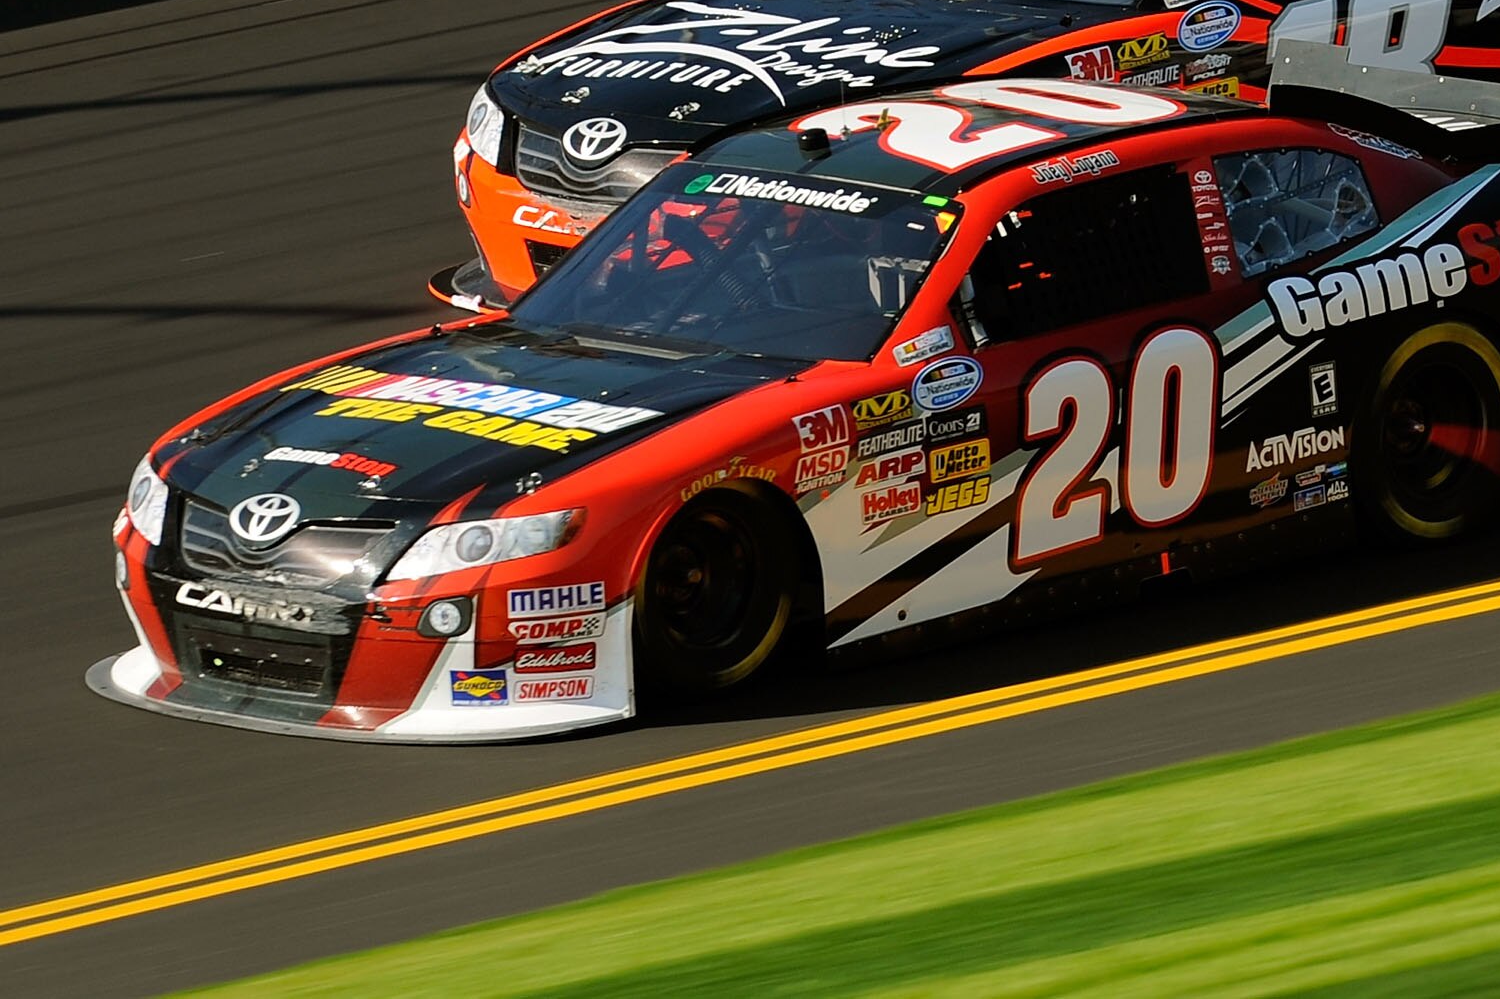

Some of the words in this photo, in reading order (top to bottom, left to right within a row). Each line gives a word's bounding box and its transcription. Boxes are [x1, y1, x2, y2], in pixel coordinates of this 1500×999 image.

[1190, 20, 1234, 36] Nationwide
[541, 55, 755, 93] FURNITURE
[755, 50, 874, 88] Designs
[1071, 48, 1114, 81] 3M
[1193, 68, 1226, 81] POLE
[788, 78, 1187, 172] 20
[1028, 161, 1073, 184] Joey
[1058, 150, 1120, 176] Logano
[730, 174, 872, 214] Nationwide
[926, 376, 975, 394] Nationwide
[1313, 372, 1334, 404] E
[376, 375, 559, 419] NASCAR
[541, 401, 666, 434] 2011
[315, 398, 435, 422] THE
[423, 410, 597, 452] GAME
[800, 407, 848, 448] 3M
[857, 422, 926, 458] FEATHERLITE
[929, 417, 965, 437] Coors
[966, 412, 981, 428] 21
[949, 445, 979, 461] Auto
[1014, 325, 1217, 565] 20
[1246, 425, 1345, 474] ACTIVISION
[263, 446, 399, 478] GameStop
[800, 449, 846, 478] MSD
[856, 449, 924, 486] ARP
[946, 455, 986, 474] Meter
[863, 486, 919, 516] Holley
[926, 477, 991, 515] JEGS
[511, 583, 604, 612] MAHLE
[514, 618, 584, 640] COMP
[515, 648, 594, 669] Edelbrock
[456, 680, 505, 690] SUNOCO
[519, 680, 588, 699] SIMPSON
